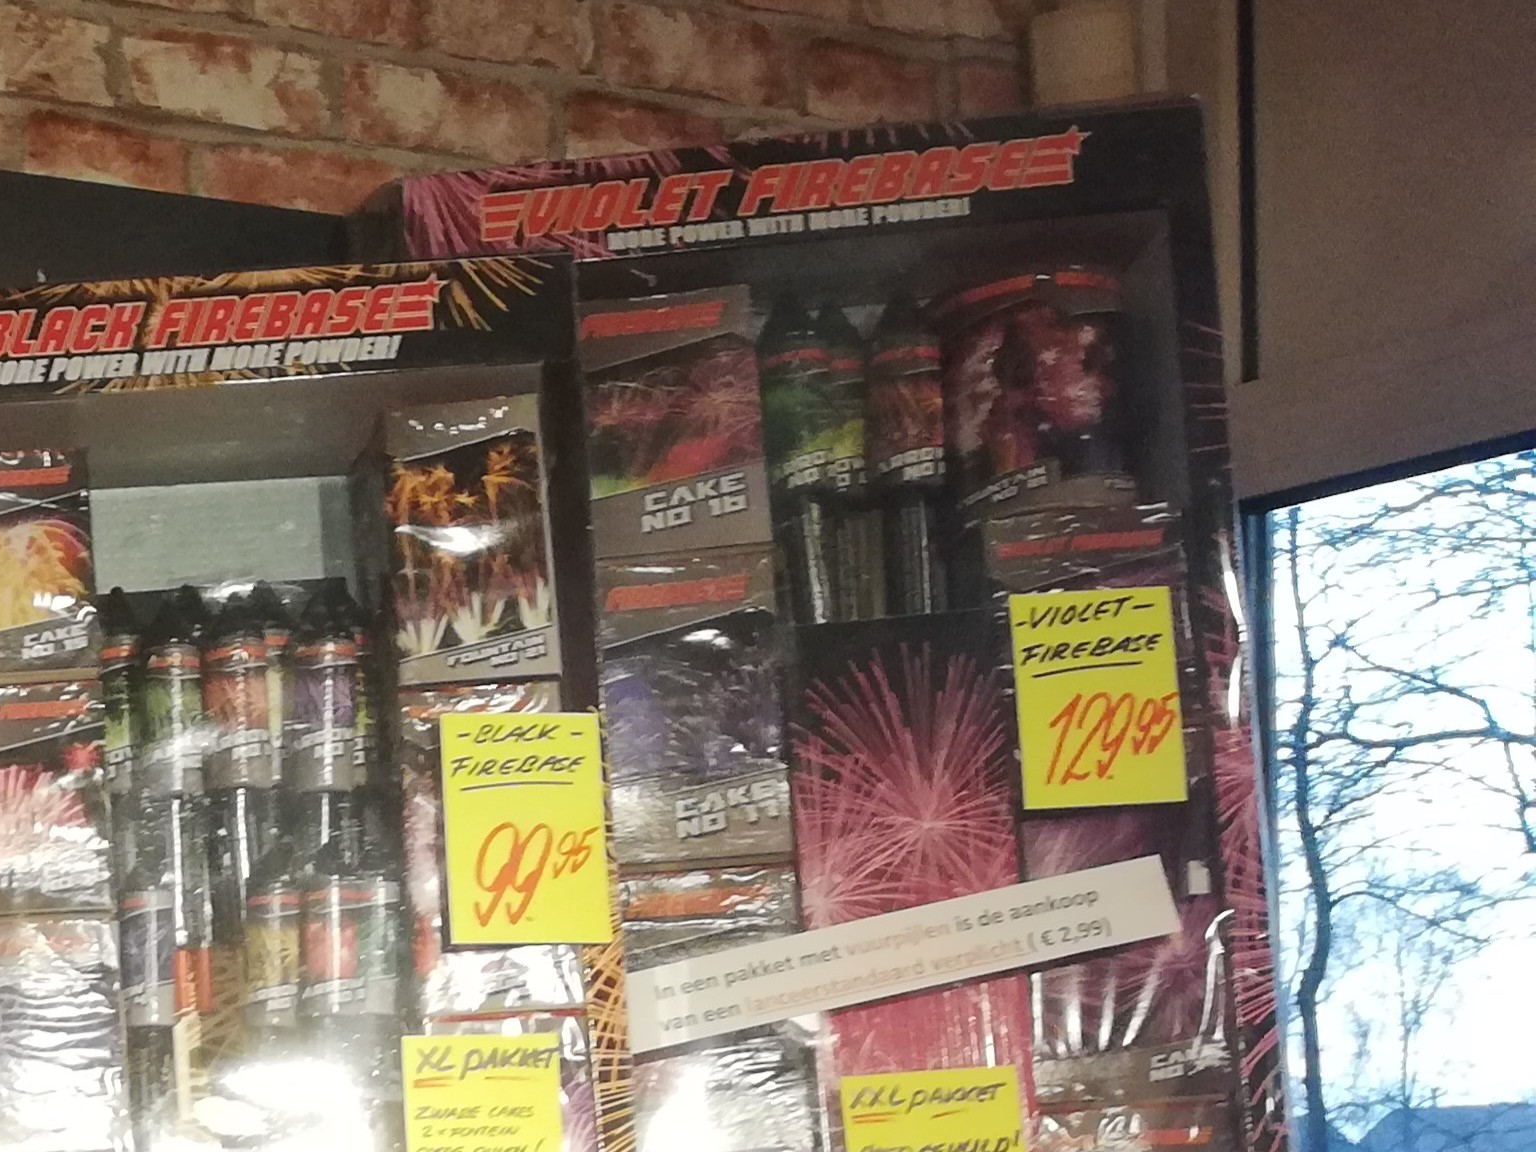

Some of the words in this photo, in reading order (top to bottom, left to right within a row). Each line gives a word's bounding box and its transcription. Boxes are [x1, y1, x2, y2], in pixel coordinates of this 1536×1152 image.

[523, 170, 732, 238] VIOLET
[738, 142, 1035, 217] FIREBASE
[607, 228, 665, 251] MORE
[669, 220, 744, 245] POWER
[749, 215, 804, 237] WITH
[808, 209, 866, 232] MORE
[152, 285, 396, 346] FIREBASE
[51, 349, 139, 381] POWER
[141, 347, 205, 375] WITH
[207, 341, 285, 372] MORE
[286, 335, 402, 365] POWDER!
[641, 473, 745, 511] CAKE
[641, 507, 691, 532] NO
[1020, 633, 1163, 665] FIREBASE
[654, 982, 676, 999] In
[680, 975, 719, 995] een
[725, 955, 794, 990] pakket
[799, 944, 842, 967] met
[955, 916, 973, 932] is
[977, 909, 1005, 929] de
[1010, 888, 1100, 922] aankoop
